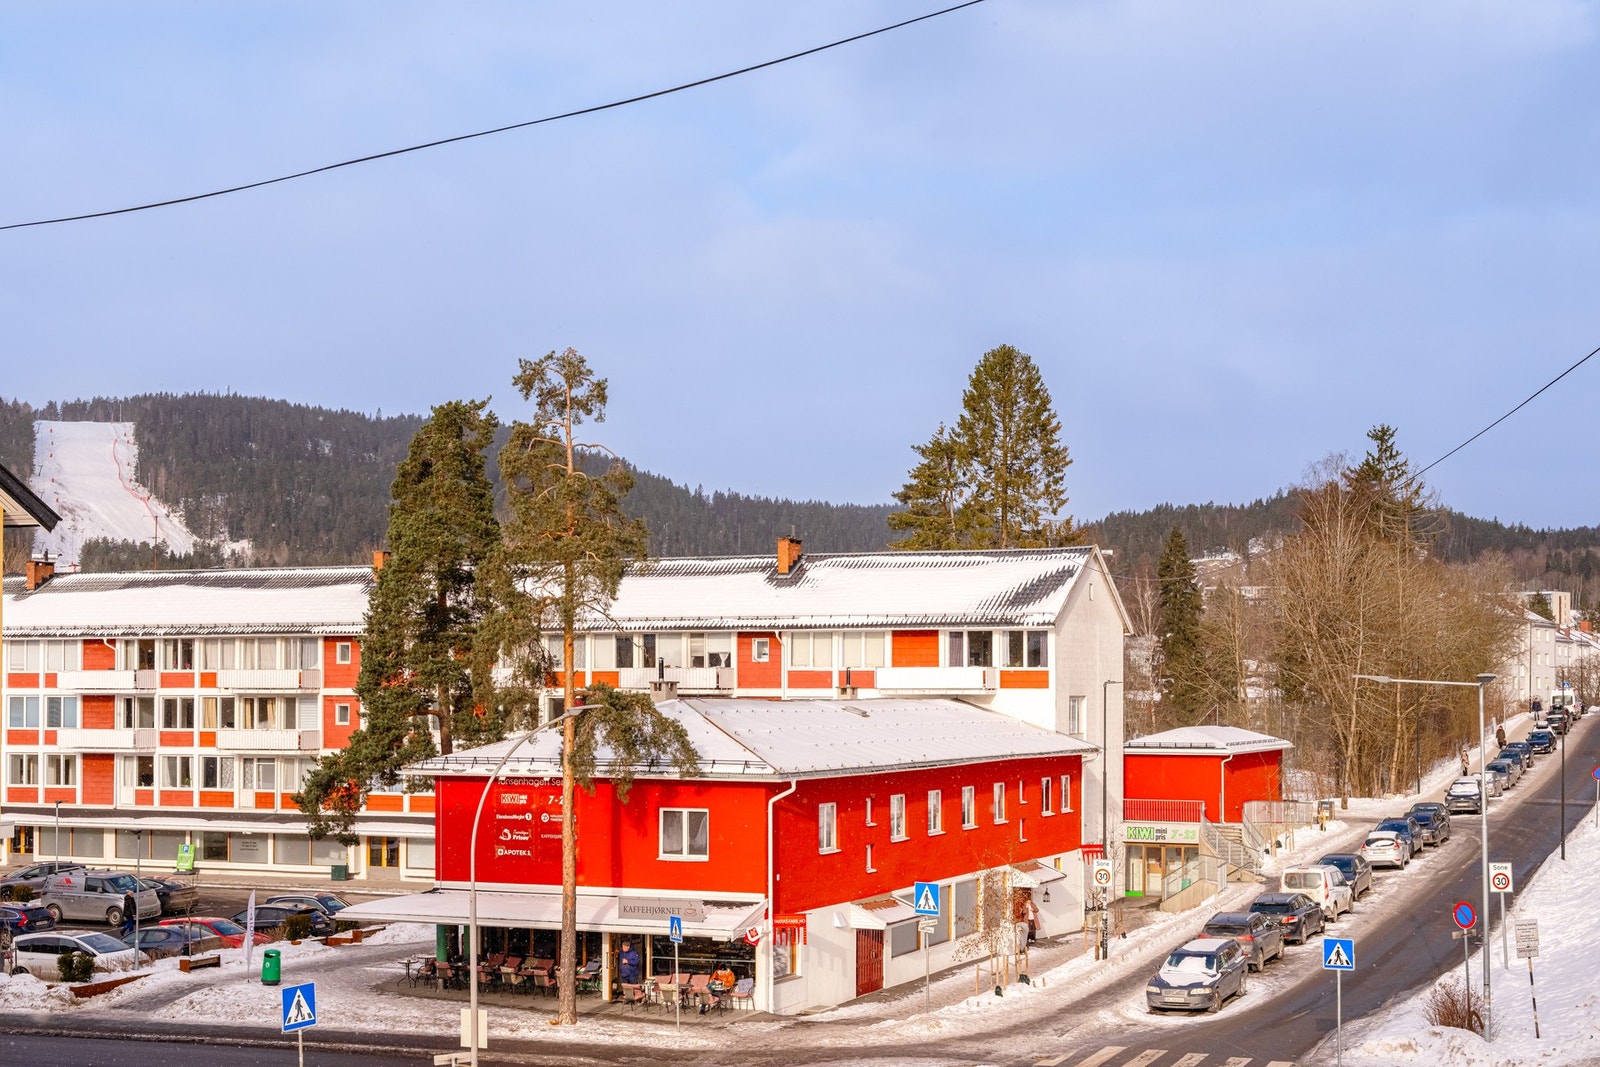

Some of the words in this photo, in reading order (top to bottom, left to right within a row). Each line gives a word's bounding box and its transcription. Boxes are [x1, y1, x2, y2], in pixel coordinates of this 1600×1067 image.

[501, 793, 520, 804] KIWI
[1127, 826, 1154, 840] KIWI
[1098, 872, 1108, 881] 30
[1496, 877, 1507, 886] 30
[623, 904, 682, 916] KAFFEHJØRNET
